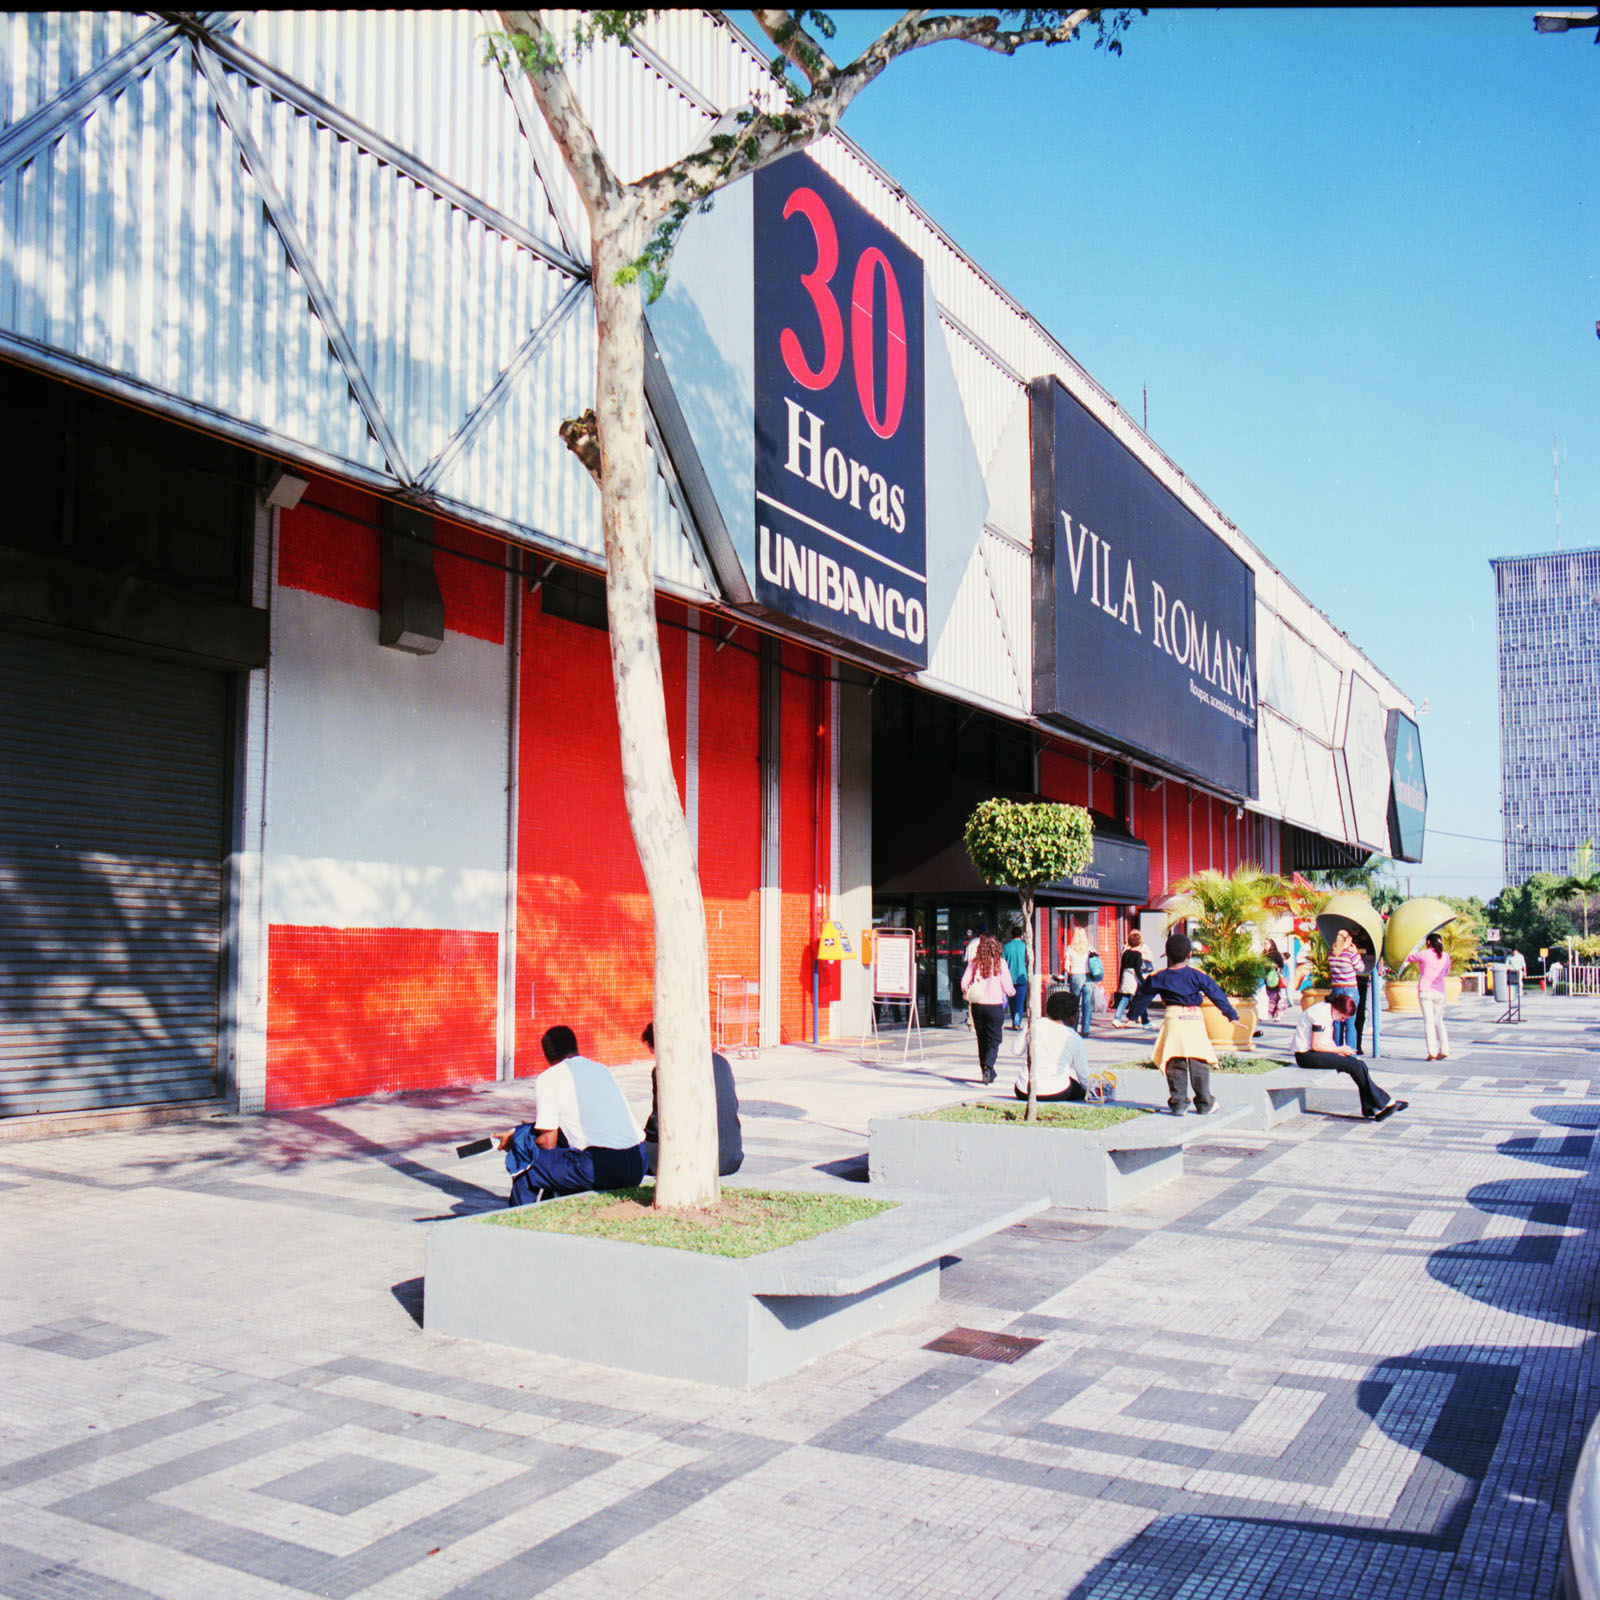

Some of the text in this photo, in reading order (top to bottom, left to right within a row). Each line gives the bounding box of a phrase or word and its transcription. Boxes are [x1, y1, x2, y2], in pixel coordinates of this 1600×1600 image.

[780, 186, 908, 439] 30
[783, 396, 907, 534] Horas
[759, 525, 926, 645] UNIBANCO
[1060, 509, 1256, 709] VILA ROMANA
